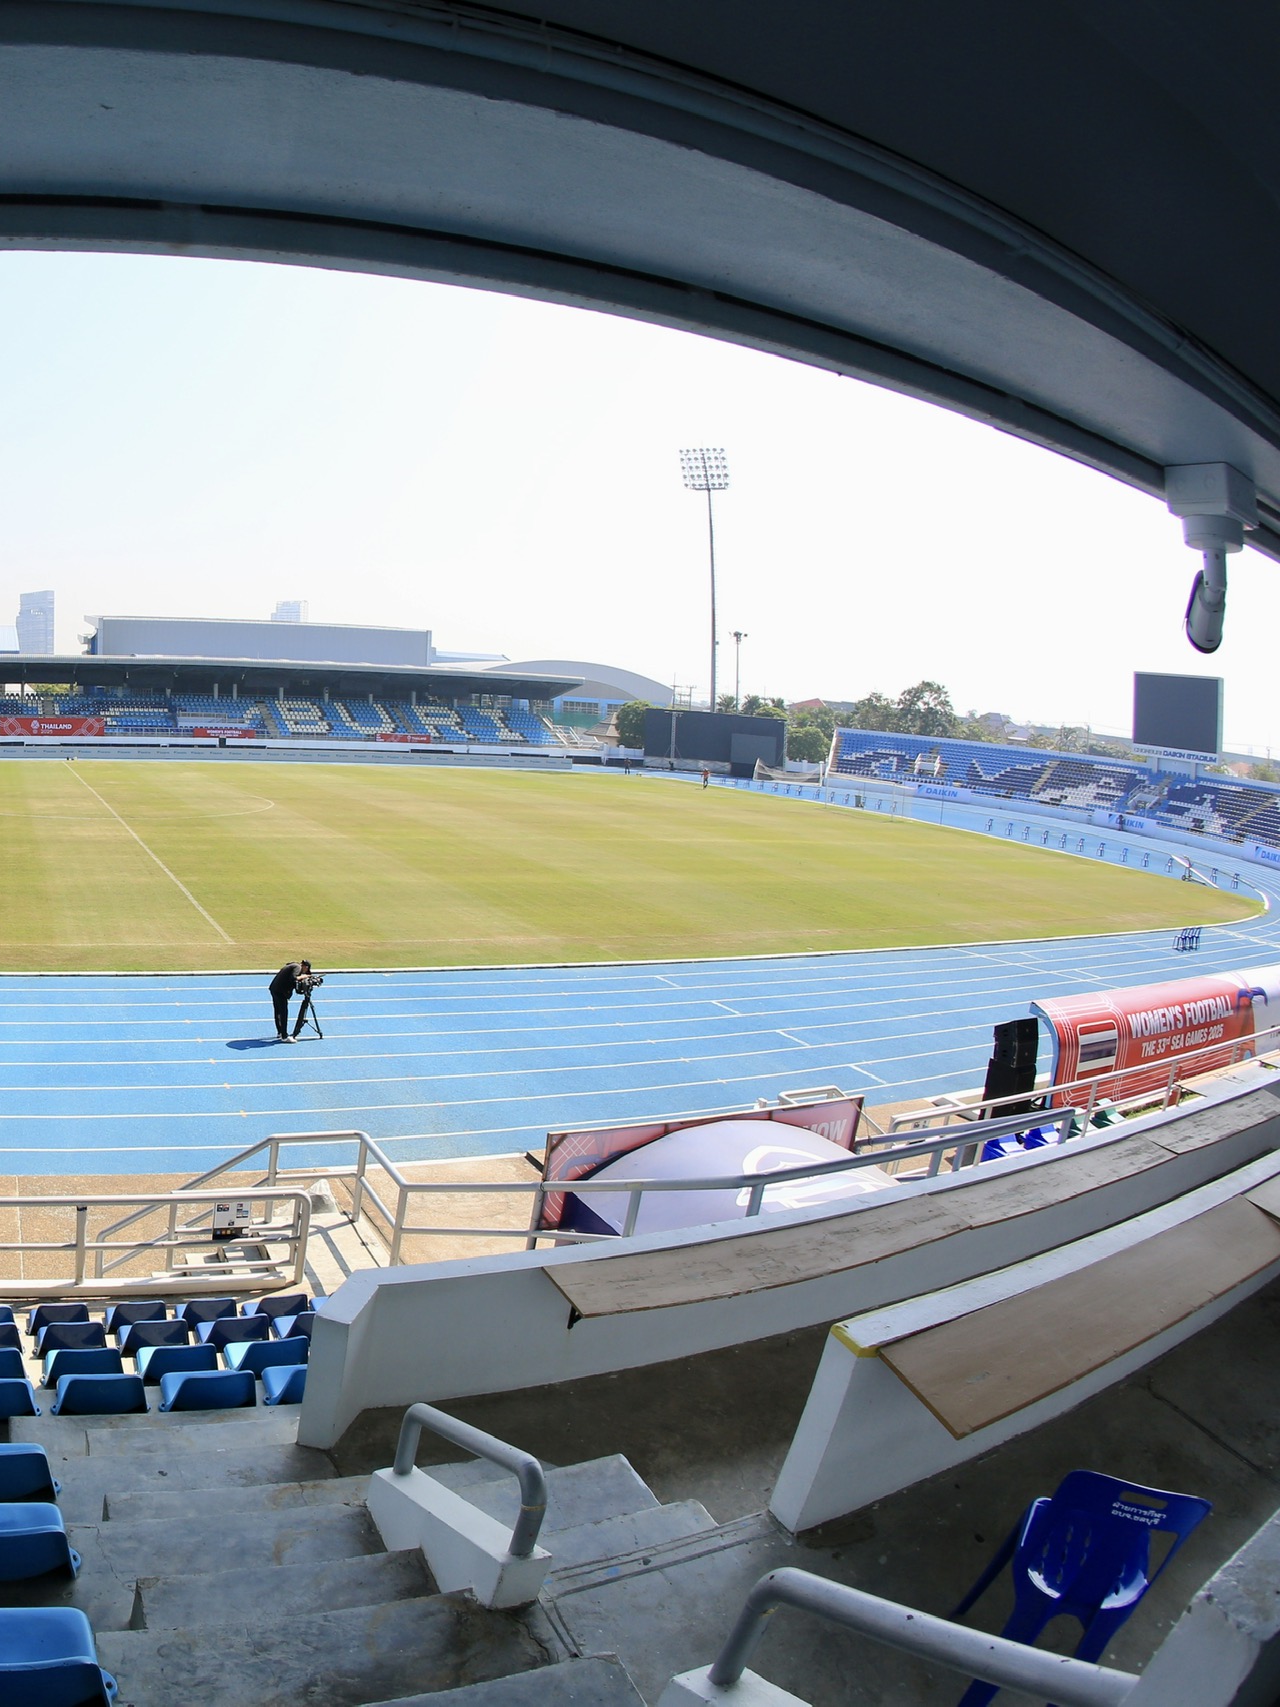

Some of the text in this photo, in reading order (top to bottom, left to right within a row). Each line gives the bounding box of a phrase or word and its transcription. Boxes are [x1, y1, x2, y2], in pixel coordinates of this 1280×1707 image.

[274, 700, 524, 741] BURI
[1163, 750, 1185, 759] DAIKIN
[1186, 753, 1217, 764] STADIUM
[925, 787, 958, 798] DAIKIN
[1126, 994, 1235, 1039] WOMEN'S FOOTBALL
[1141, 1041, 1156, 1058] THE
[1170, 1034, 1184, 1050] SEA
[1185, 1028, 1208, 1047] GAMES
[1208, 1023, 1224, 1041] 2025
